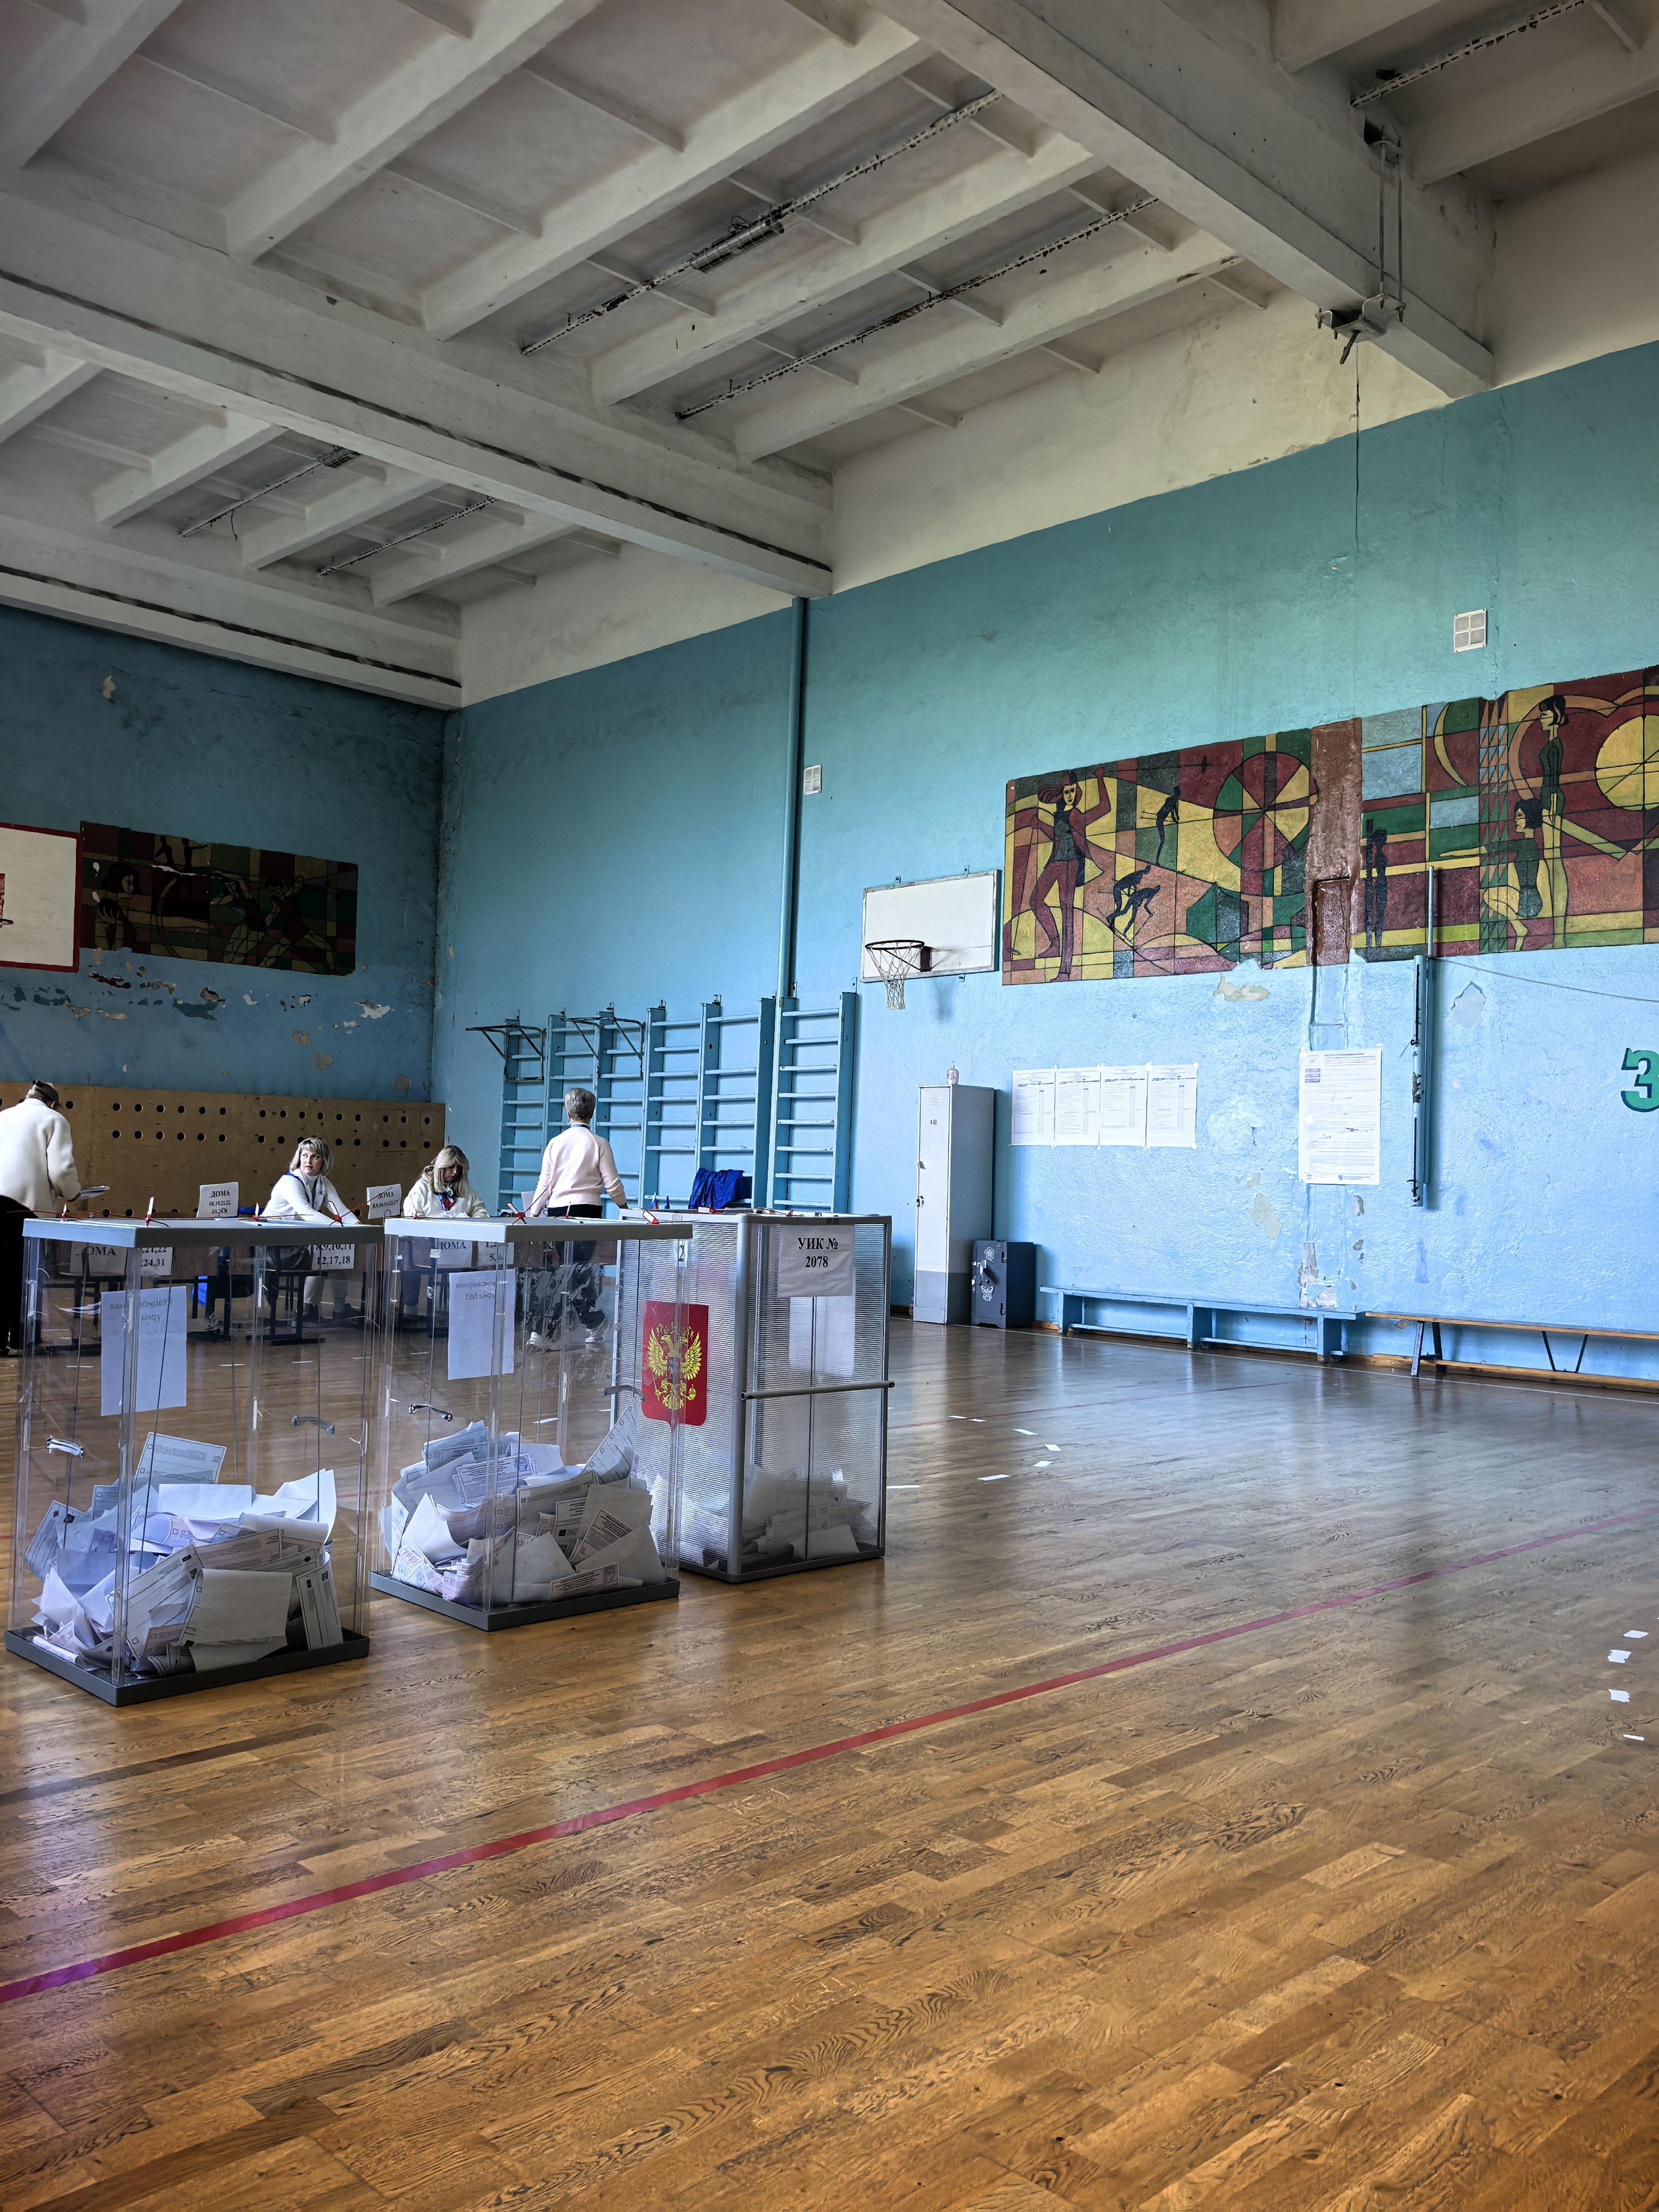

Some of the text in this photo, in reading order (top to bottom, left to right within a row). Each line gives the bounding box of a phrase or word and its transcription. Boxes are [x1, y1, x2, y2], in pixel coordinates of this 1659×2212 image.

[211, 1190, 230, 1198] ДОМА
[797, 1237, 838, 1250] УИК №
[76, 1246, 116, 1256] ОМА
[805, 1256, 828, 1268] 2078
